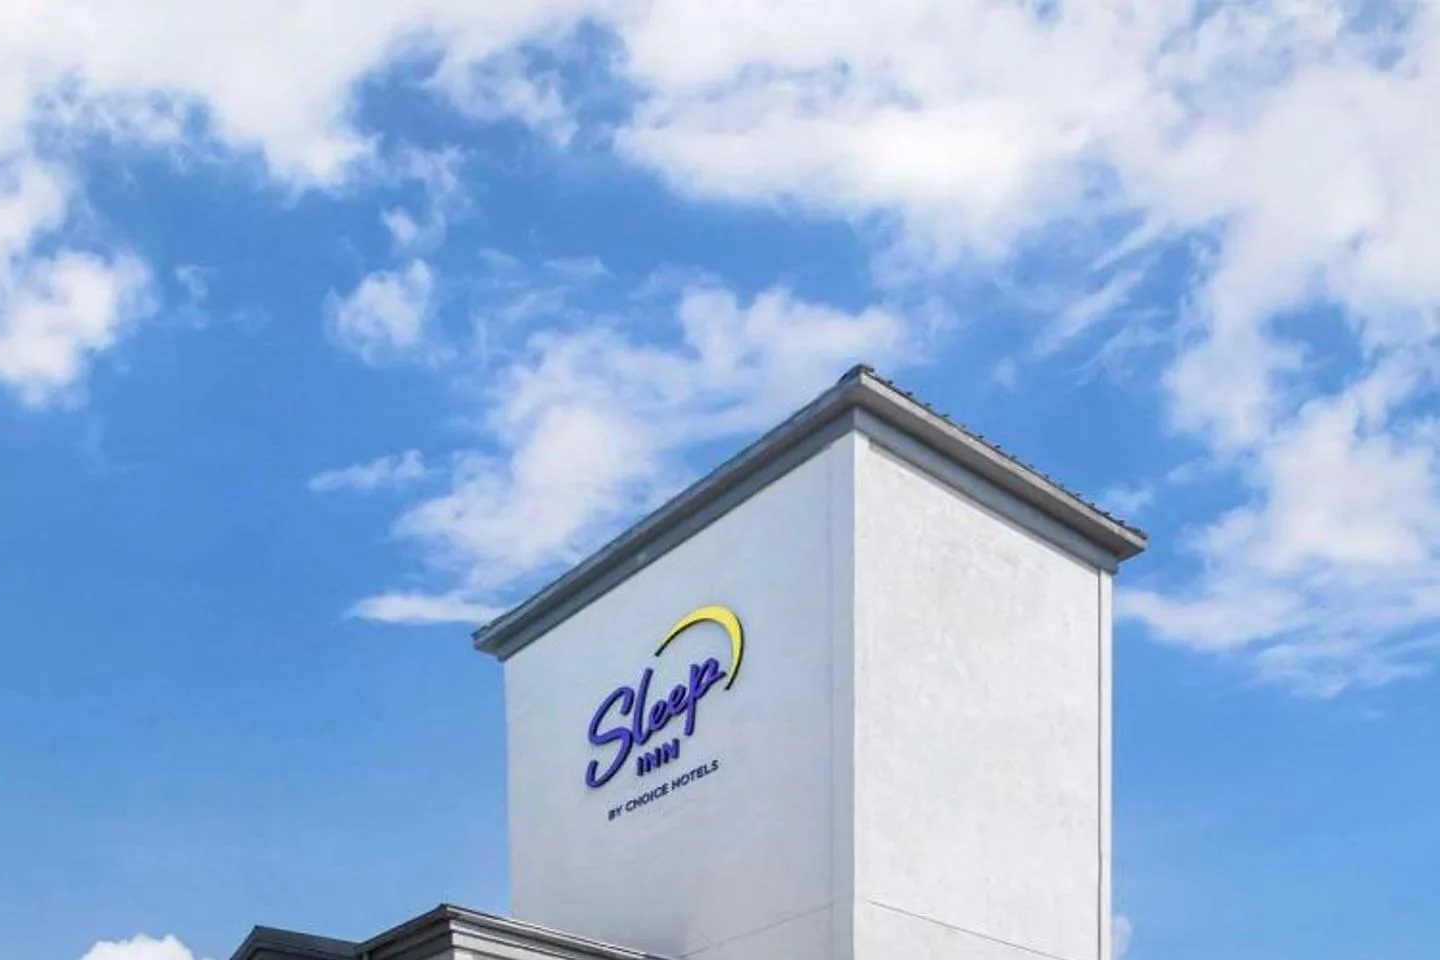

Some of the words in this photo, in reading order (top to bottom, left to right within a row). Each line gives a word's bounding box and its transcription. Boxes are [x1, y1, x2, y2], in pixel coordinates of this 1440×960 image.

[585, 658, 727, 789] Sleep
[637, 738, 680, 777] INN
[608, 804, 623, 821] BY
[625, 782, 669, 812] CHOICE
[671, 759, 719, 791] HOTELS
